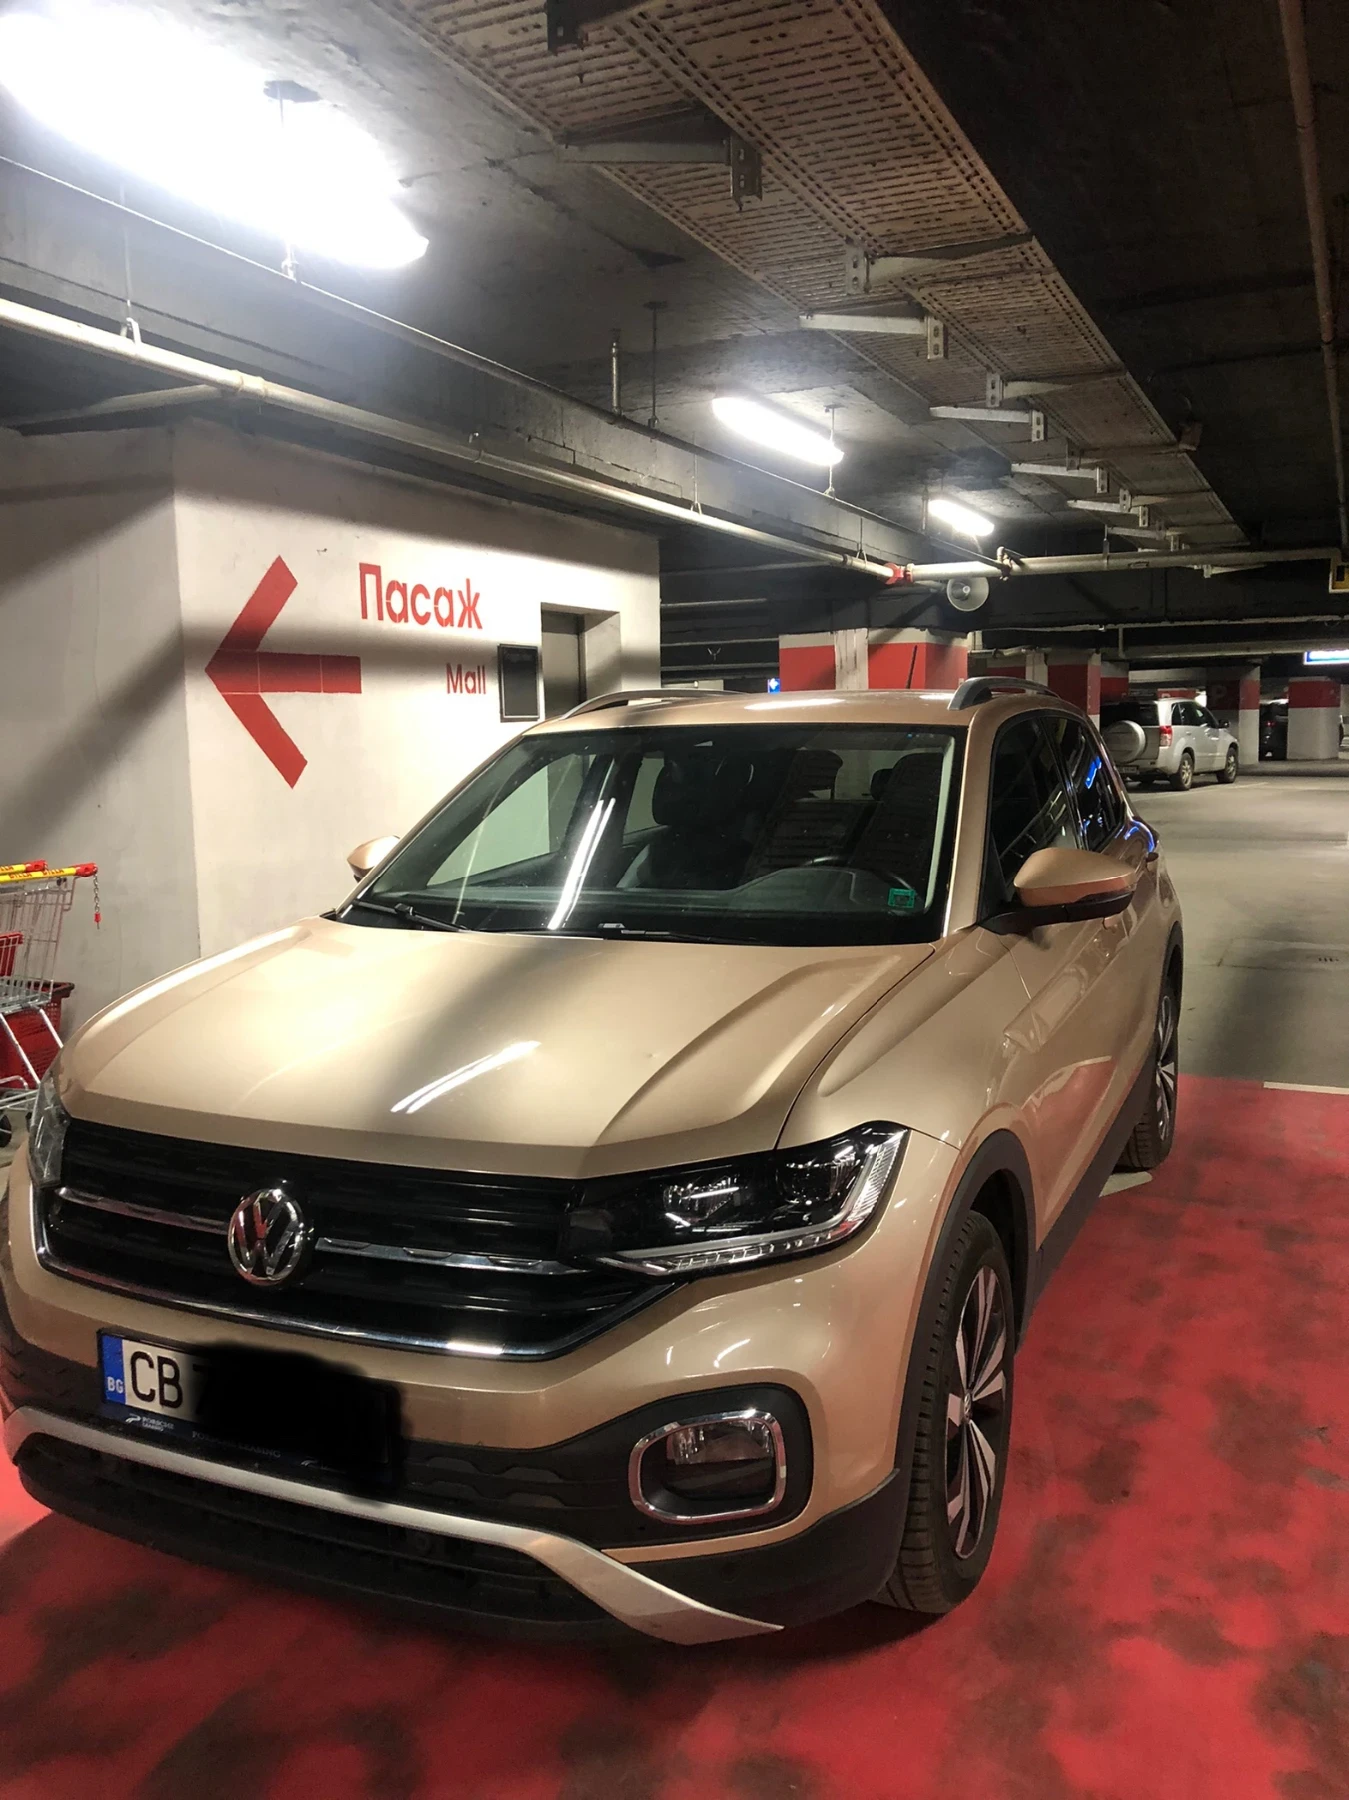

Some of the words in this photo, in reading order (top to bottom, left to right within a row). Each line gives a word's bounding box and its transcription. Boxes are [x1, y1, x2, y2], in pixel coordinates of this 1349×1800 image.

[358, 561, 484, 630] Пасаж
[445, 662, 487, 695] Mall
[107, 1376, 124, 1394] BG
